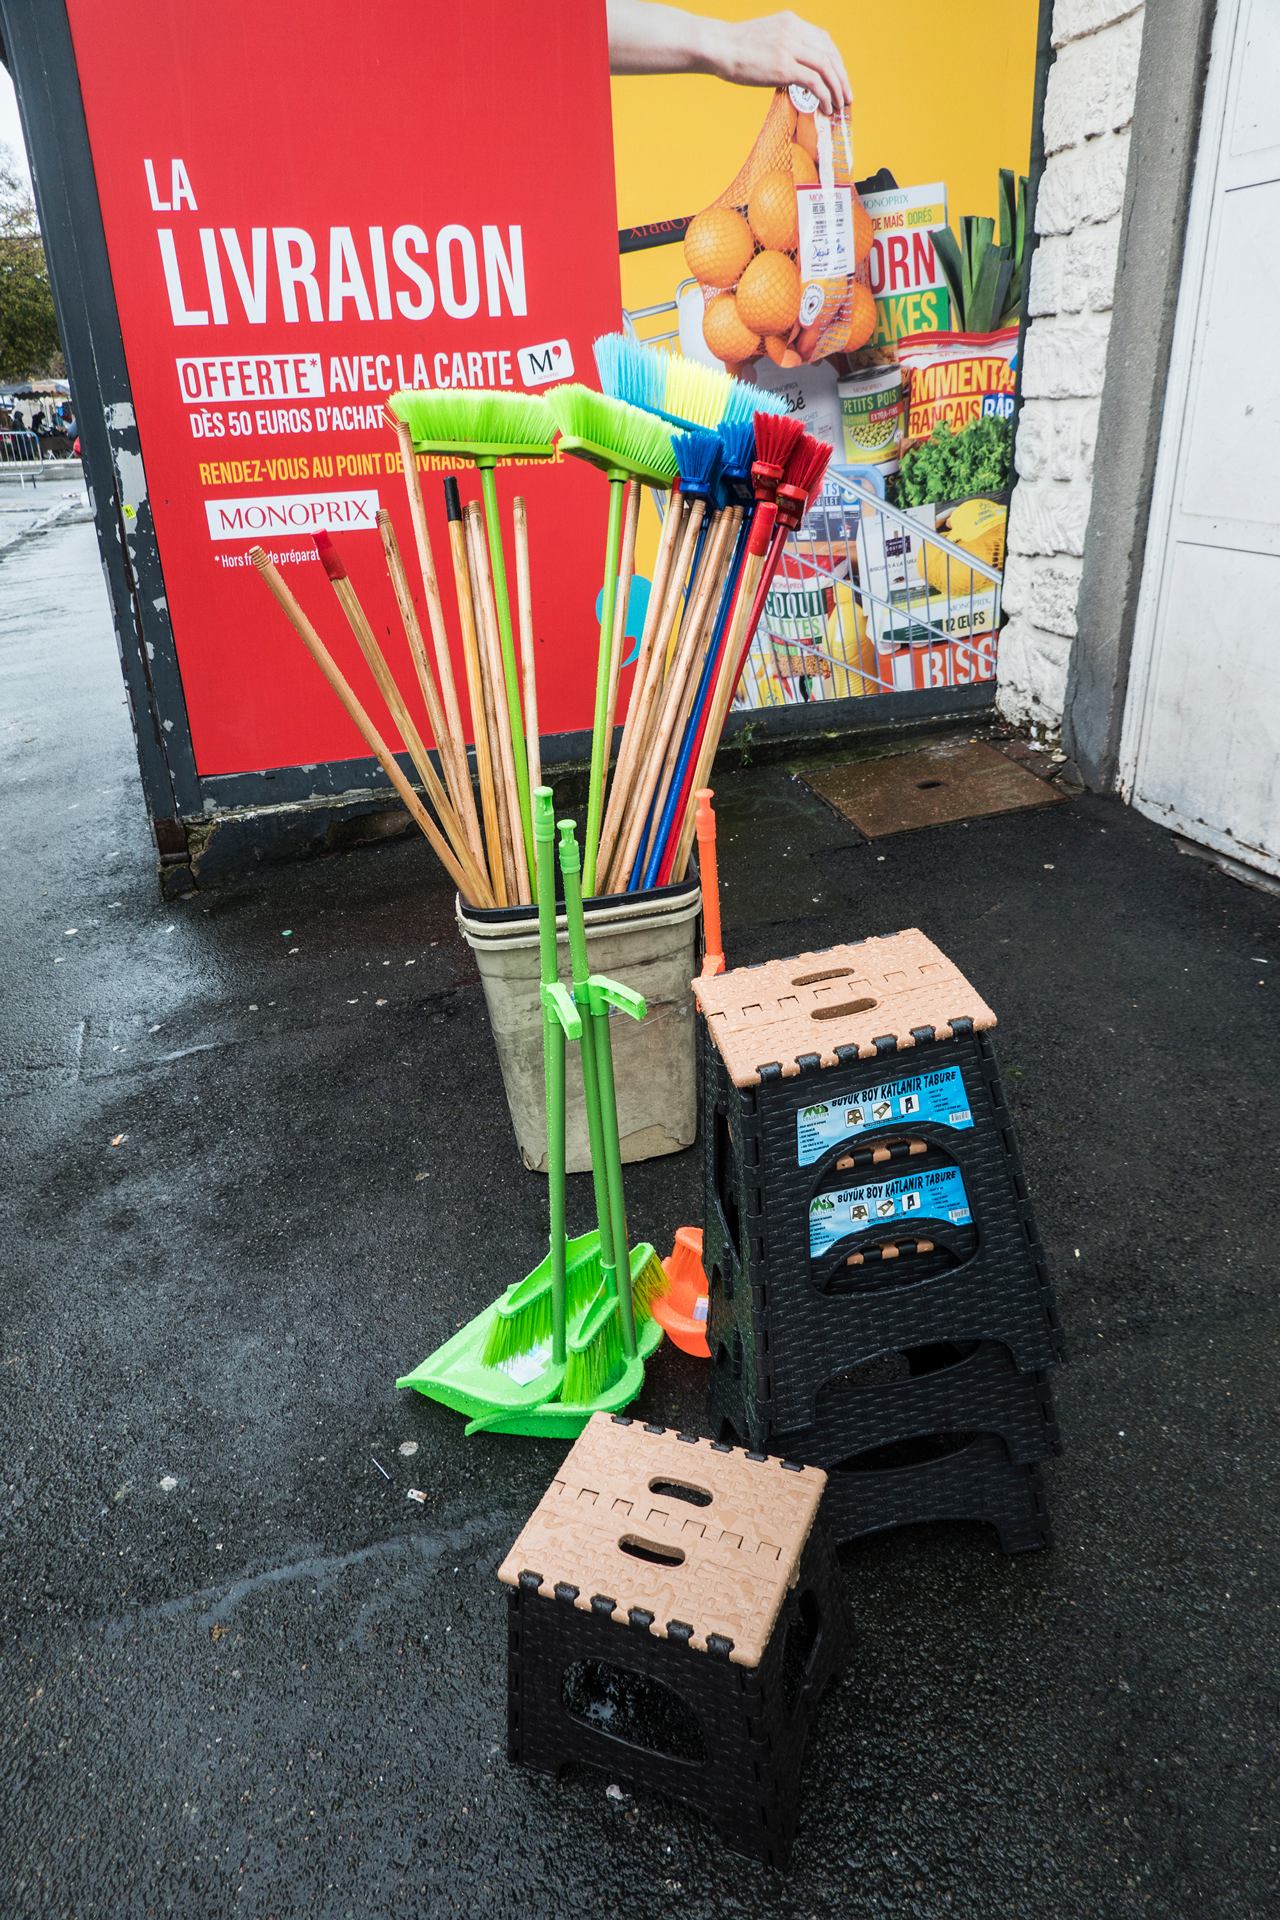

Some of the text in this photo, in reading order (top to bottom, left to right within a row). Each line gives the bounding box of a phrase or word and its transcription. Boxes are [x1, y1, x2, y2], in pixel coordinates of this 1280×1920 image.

[144, 159, 198, 211] LA
[157, 224, 528, 326] LIVRAISON
[869, 230, 936, 295] ORN
[872, 291, 938, 344] AKES
[329, 355, 393, 393] AVEC
[396, 354, 433, 390] LA
[434, 350, 514, 388] CARTE
[843, 389, 898, 414] PETITS POIS
[190, 407, 226, 438] DÈS
[229, 412, 253, 436] 50
[256, 409, 313, 435] EUROS
[199, 457, 310, 485] RENDEZ-VOUS
[312, 456, 334, 478] AU
[336, 453, 382, 477] POINT
[386, 452, 404, 474] DE
[218, 499, 371, 531] MONOPRIX
[280, 548, 321, 566] préparat
[923, 1071, 956, 1088] TABURE
[925, 1170, 956, 1187] TABURE
